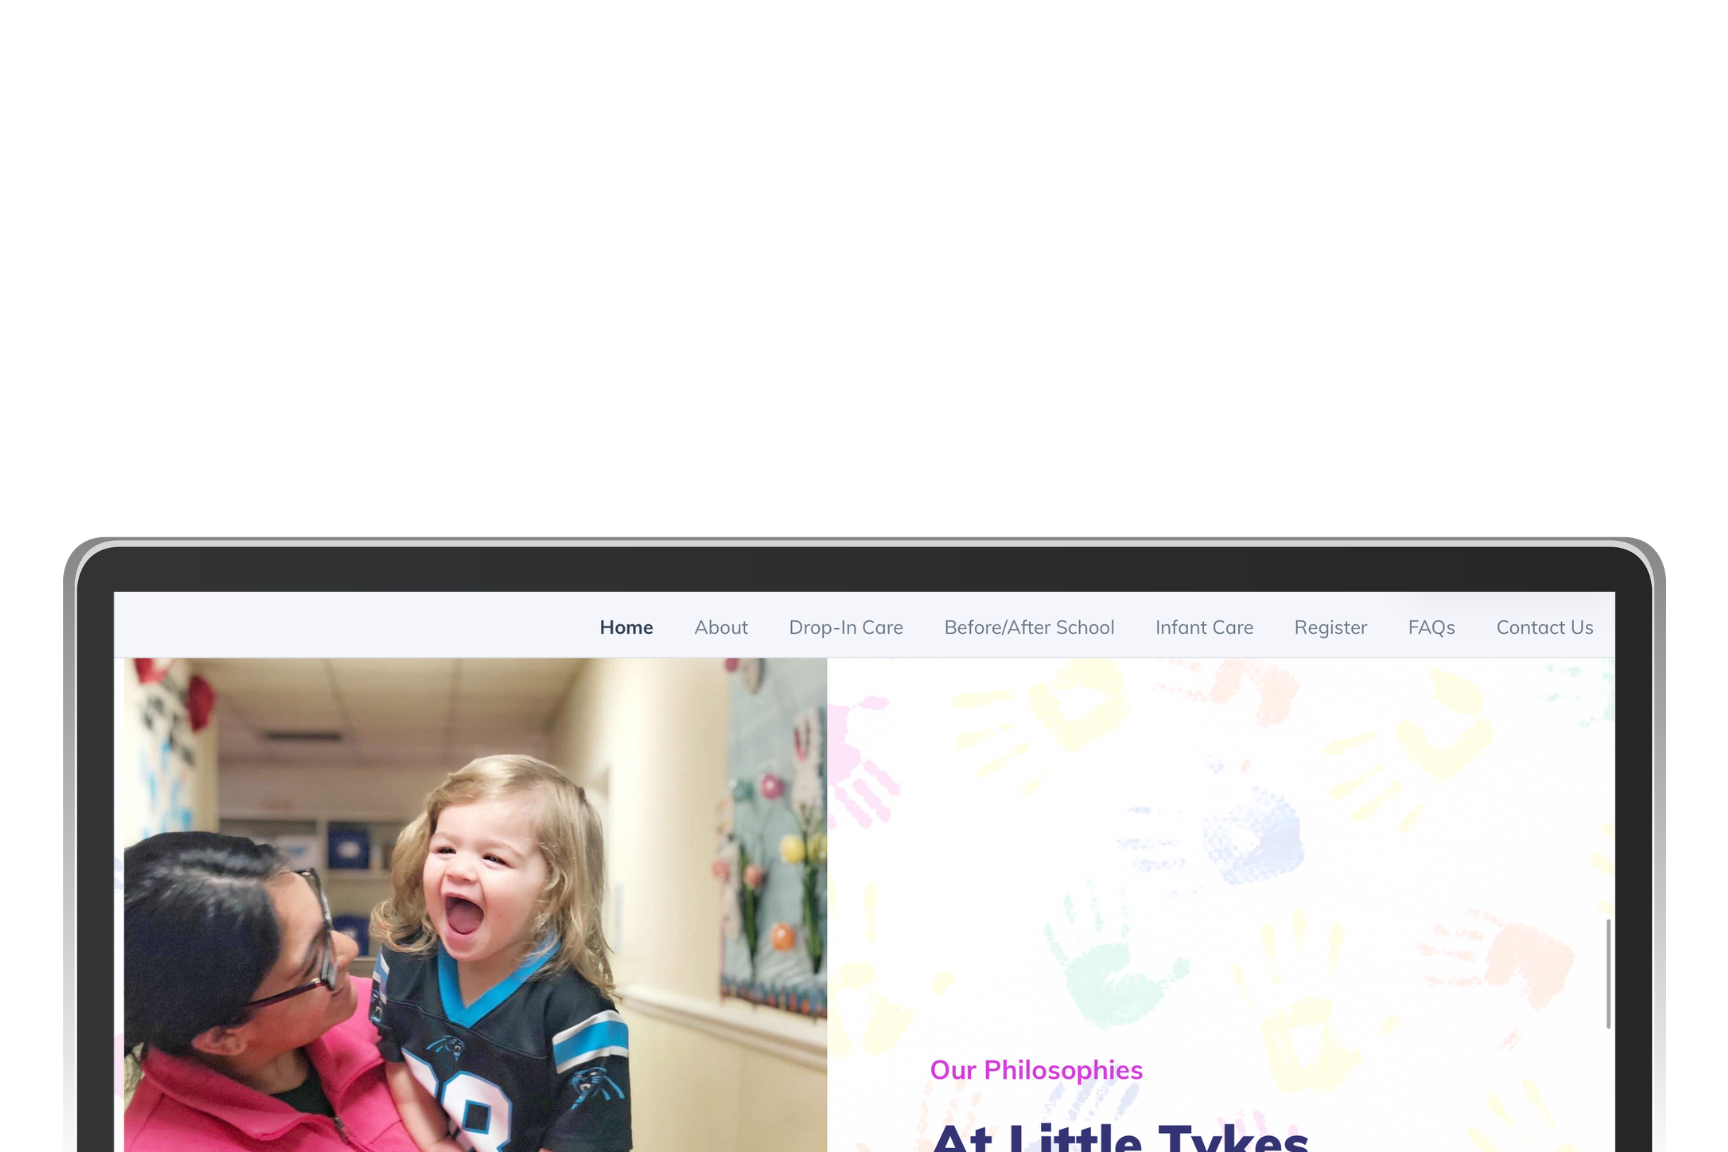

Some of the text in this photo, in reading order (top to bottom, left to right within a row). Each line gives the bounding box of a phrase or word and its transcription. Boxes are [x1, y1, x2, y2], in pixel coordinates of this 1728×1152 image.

[600, 619, 654, 635] Home
[694, 619, 749, 635] About
[790, 619, 904, 639] Drop-In Care
[945, 619, 1115, 636] Before/After School
[1156, 619, 1254, 635] Infant Care
[1295, 619, 1368, 639] Register
[1409, 619, 1456, 638] FAQs
[1496, 619, 1594, 635] Contact Us
[930, 1059, 1143, 1086] Our Philosophies
